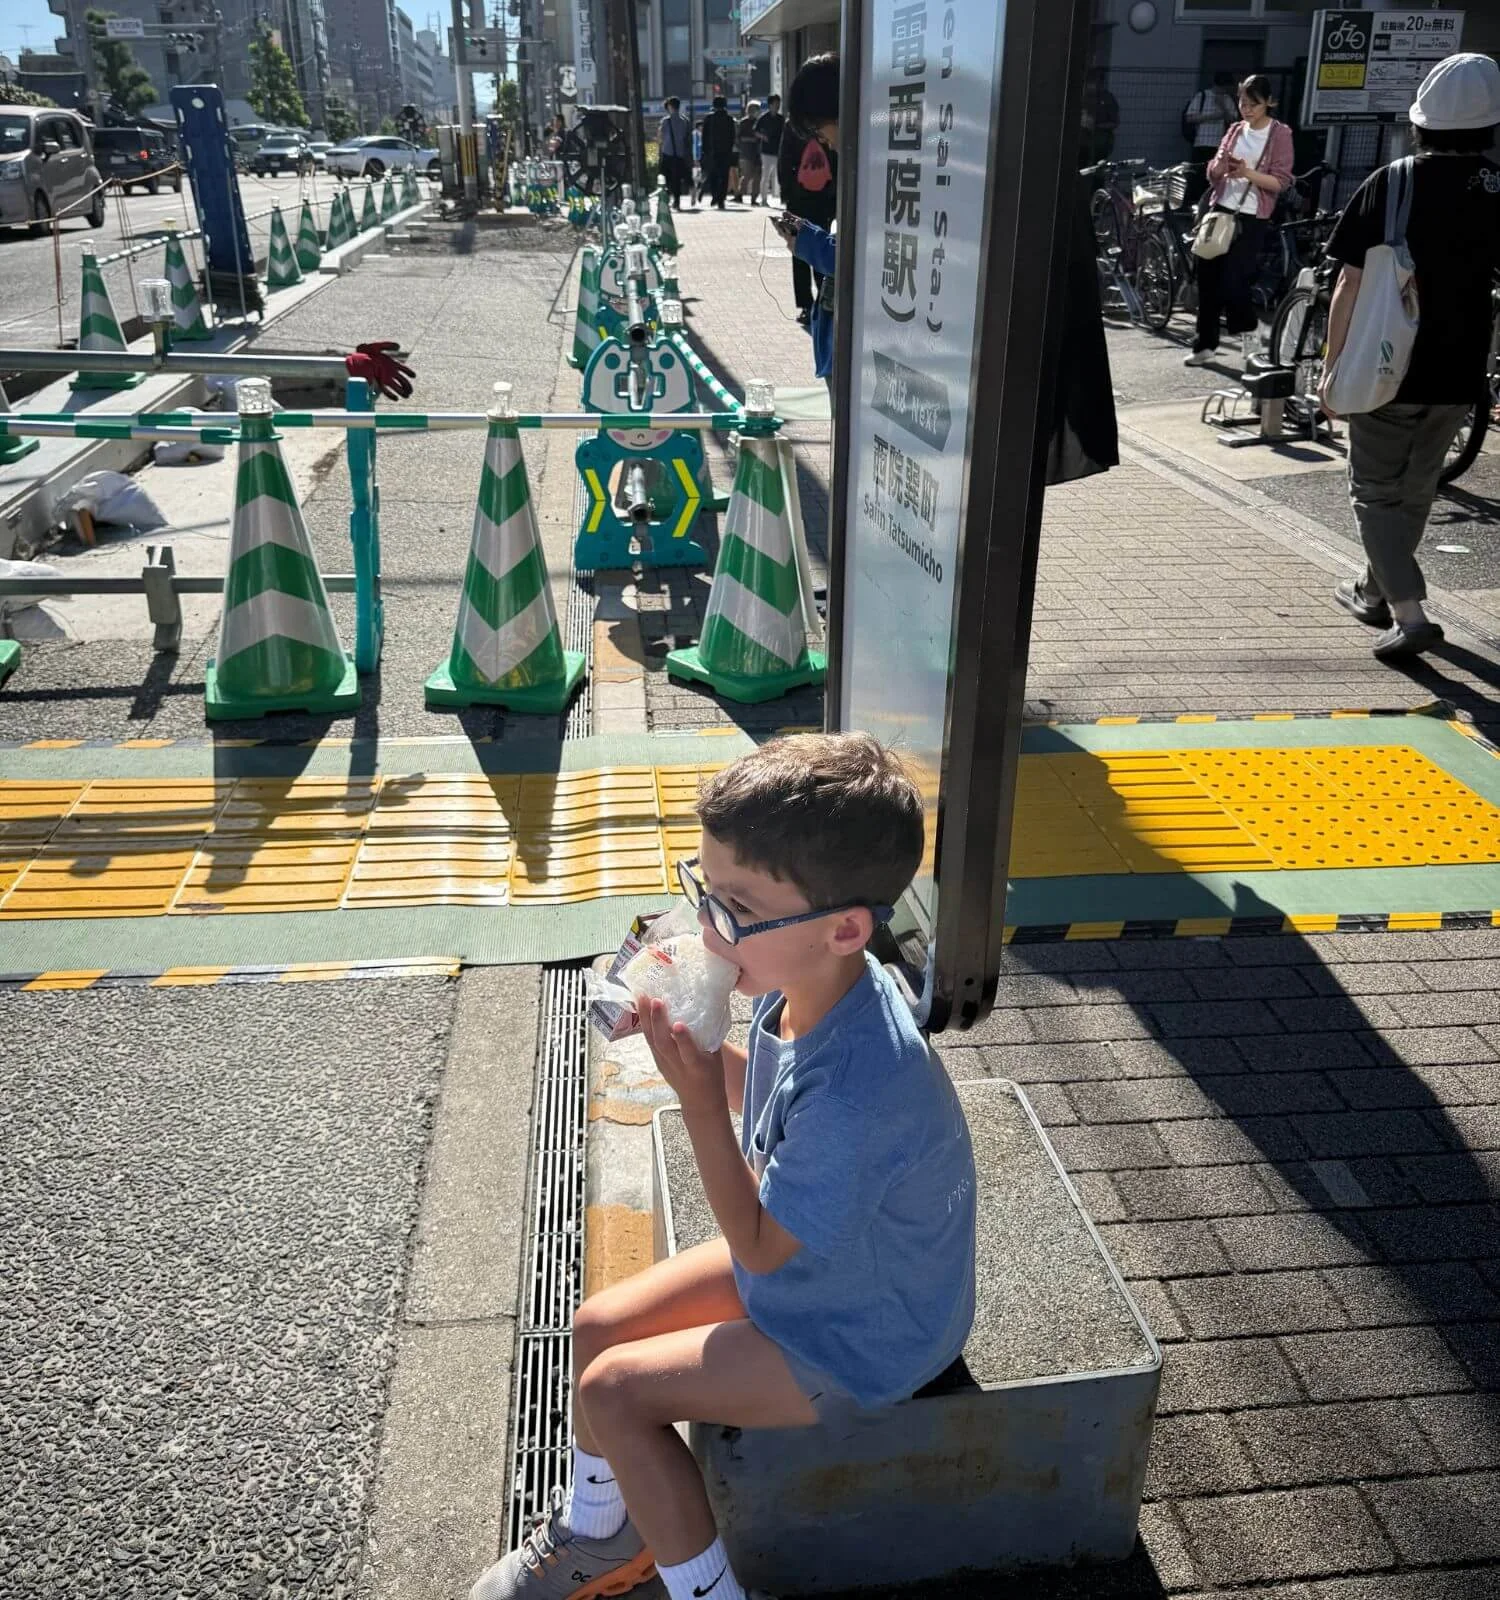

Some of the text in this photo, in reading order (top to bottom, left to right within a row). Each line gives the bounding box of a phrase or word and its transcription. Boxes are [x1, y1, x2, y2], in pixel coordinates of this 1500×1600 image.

[881, 0, 927, 323] 電西院駅)
[936, 103, 953, 186] Sai
[912, 395, 939, 435] Next
[863, 492, 943, 584] Saiin Tatsumicho
